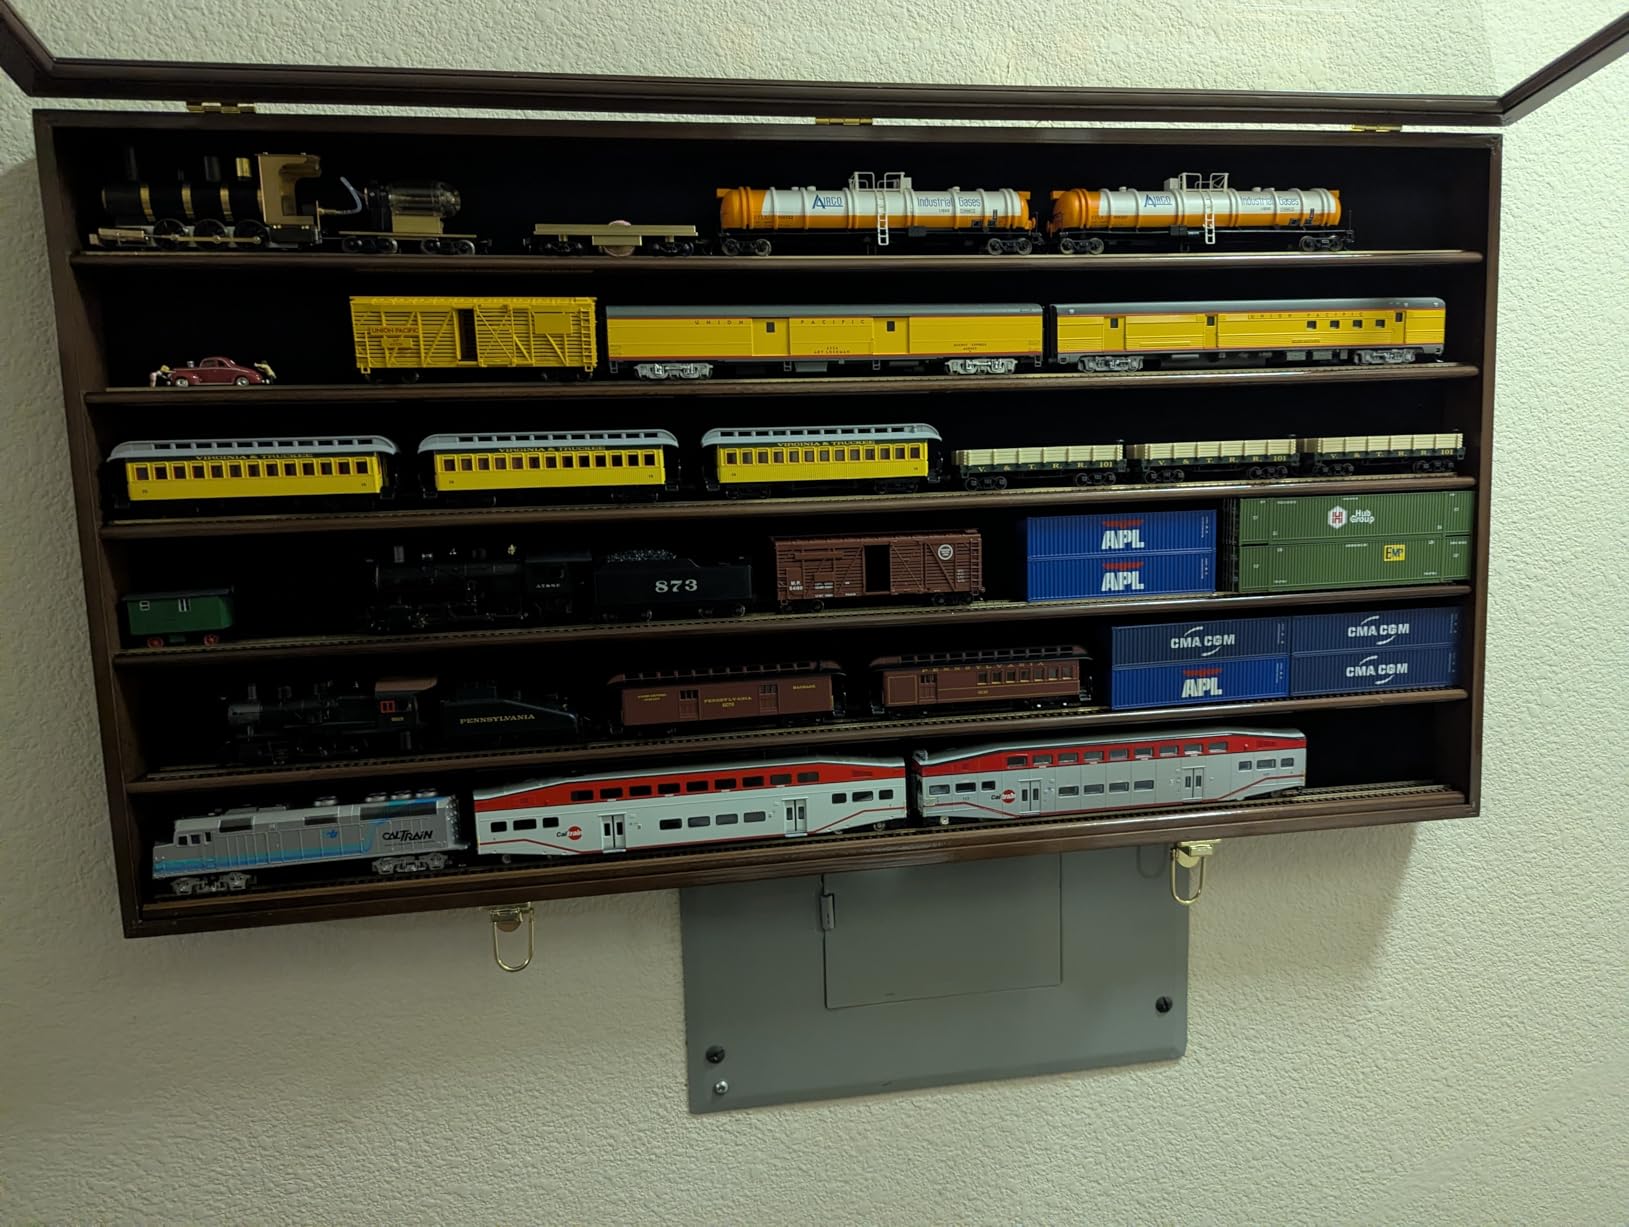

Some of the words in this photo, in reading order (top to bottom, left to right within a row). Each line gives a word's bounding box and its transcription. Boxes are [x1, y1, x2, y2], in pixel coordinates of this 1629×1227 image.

[812, 194, 843, 209] AIRCO
[917, 196, 953, 207] Industrial
[1350, 515, 1375, 525] Group
[1355, 509, 1372, 518] Hub
[1101, 529, 1145, 550] APL
[655, 578, 698, 593] 873
[1101, 571, 1145, 591] APL
[1347, 625, 1377, 638] CMA
[1379, 623, 1410, 636] CGM
[1170, 637, 1201, 649] CMA
[1204, 634, 1236, 647] CGM
[1346, 665, 1376, 678] CMA
[1378, 663, 1409, 675] CGM
[1181, 677, 1223, 698] APL
[459, 714, 536, 725] PENNSYLVANIA
